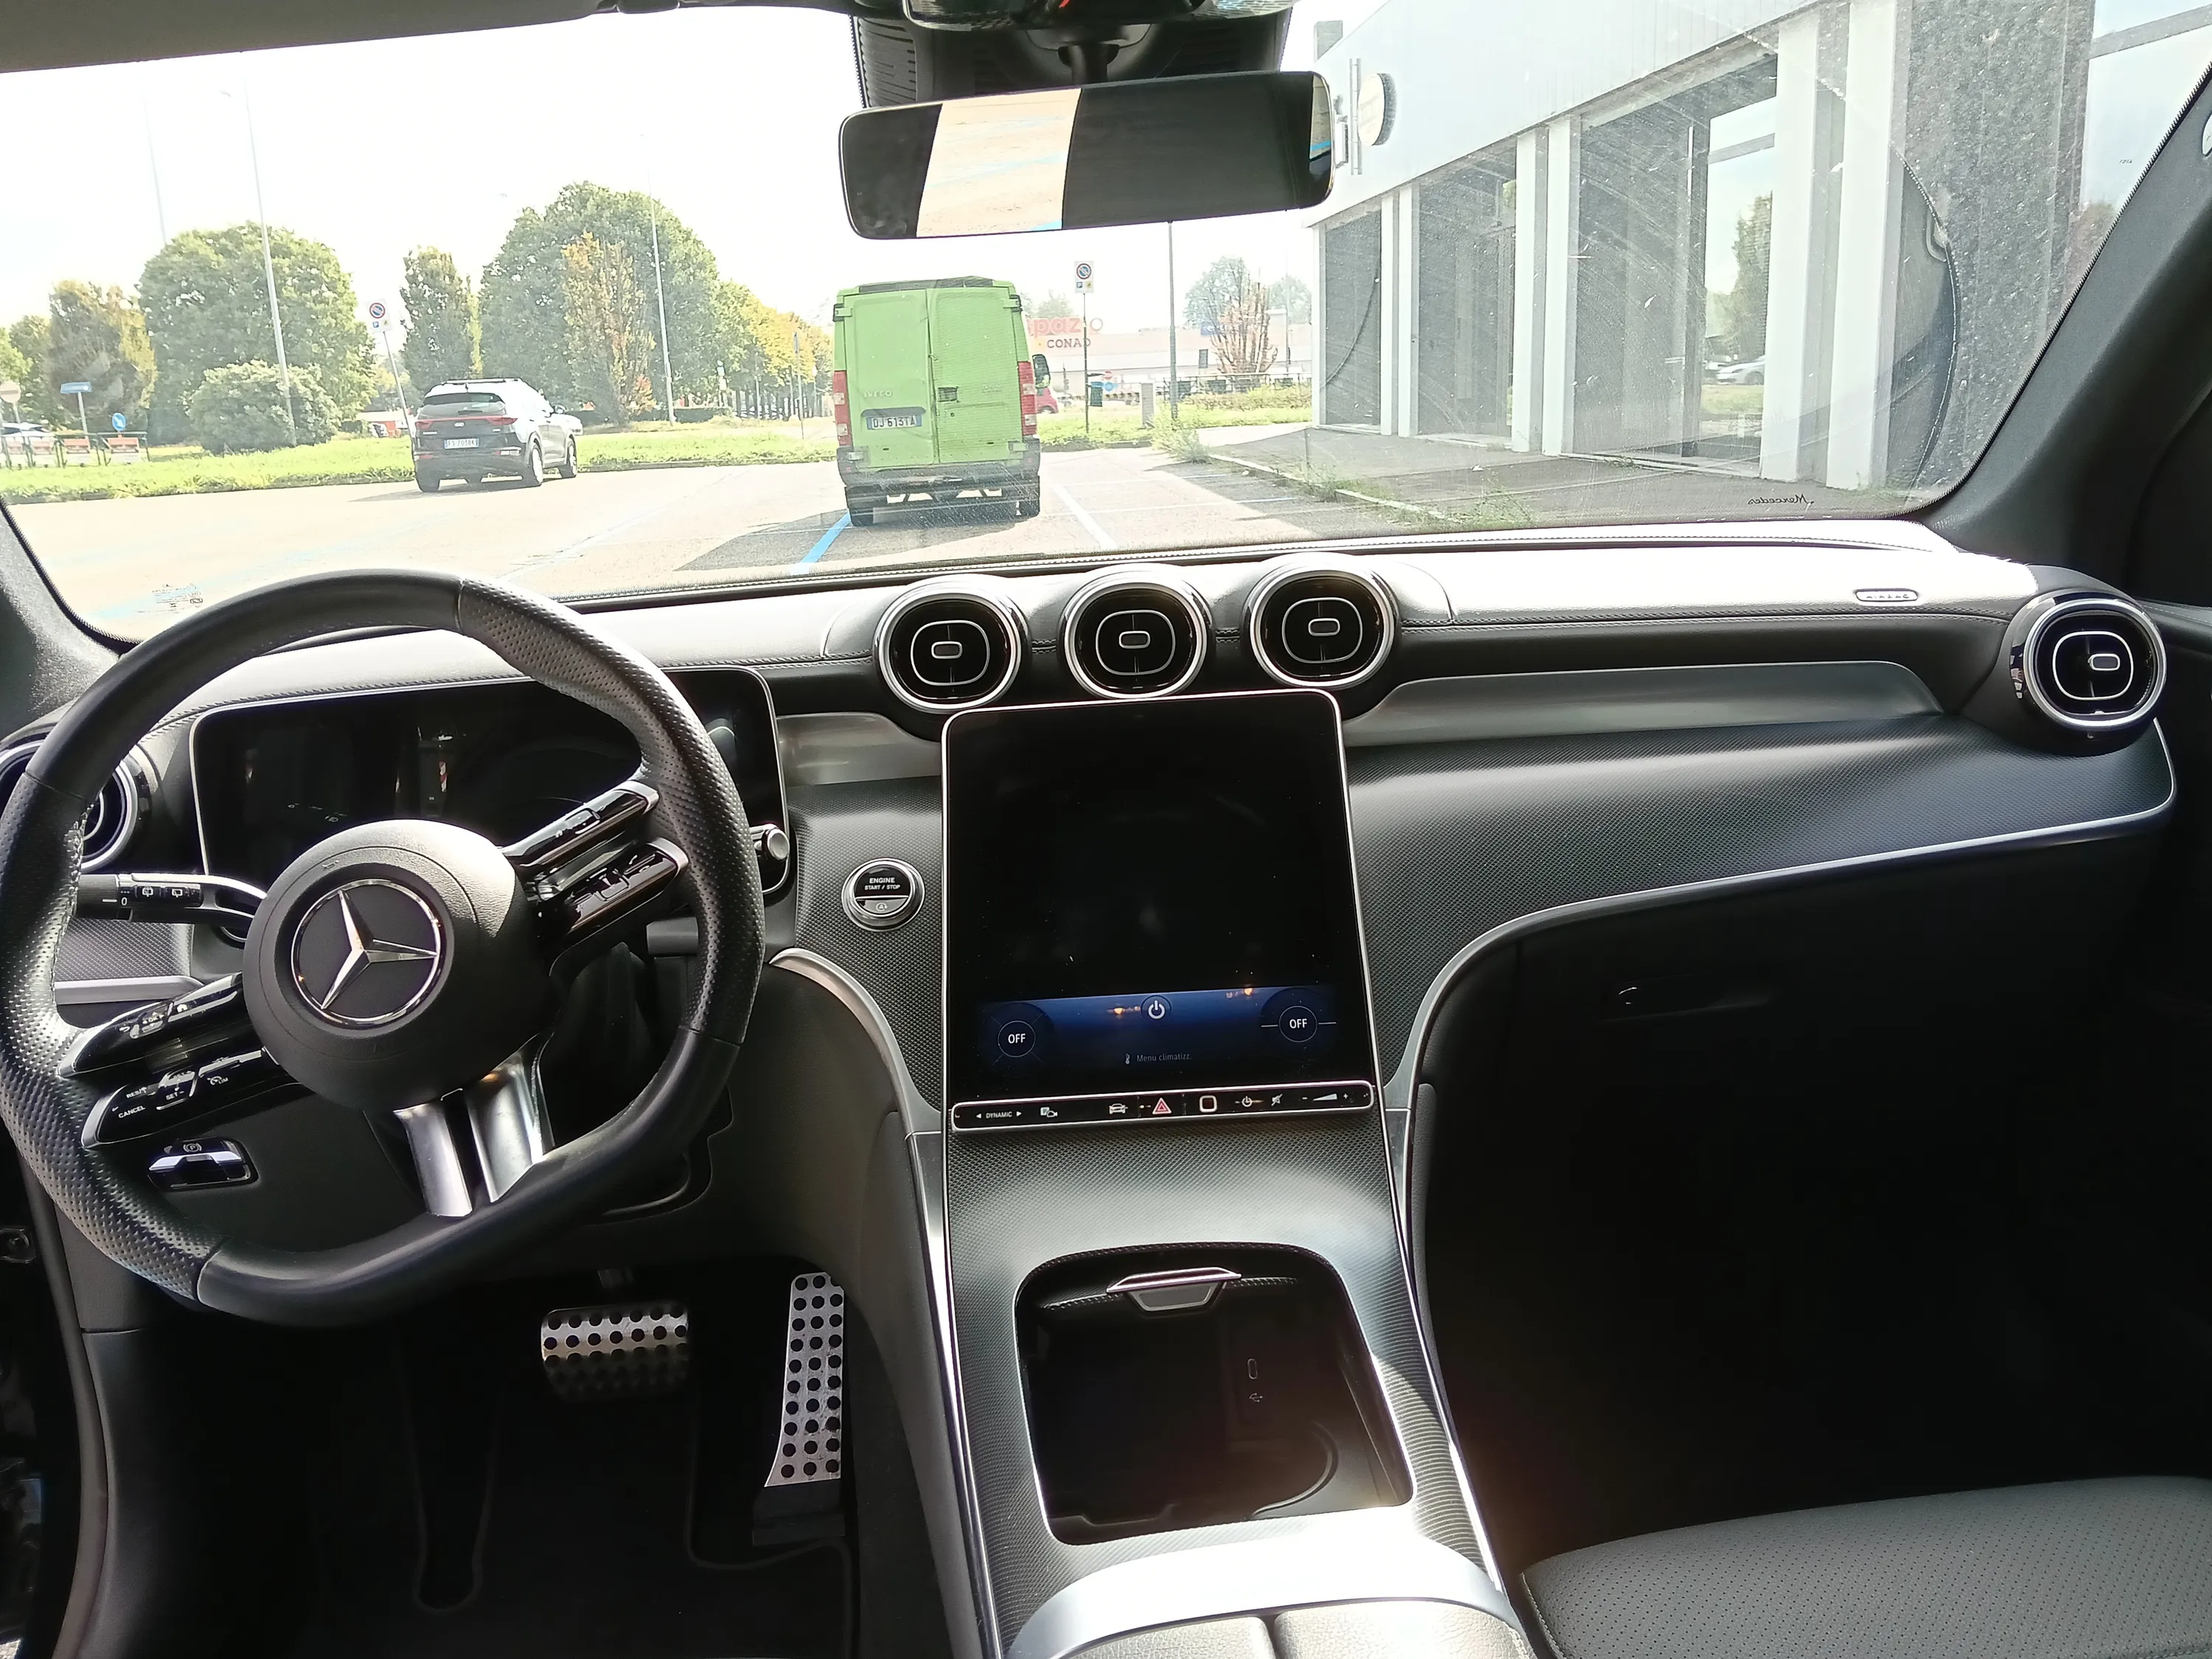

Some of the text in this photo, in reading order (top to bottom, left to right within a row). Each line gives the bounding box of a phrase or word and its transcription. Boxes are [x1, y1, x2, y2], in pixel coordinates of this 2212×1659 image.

[1047, 338, 1091, 348] CONAD
[863, 389, 893, 398] IVECO
[1289, 1018, 1307, 1029] OFF
[1008, 1033, 1026, 1044] OFF
[218, 1077, 229, 1085] LIM
[118, 1105, 146, 1119] CANCEL
